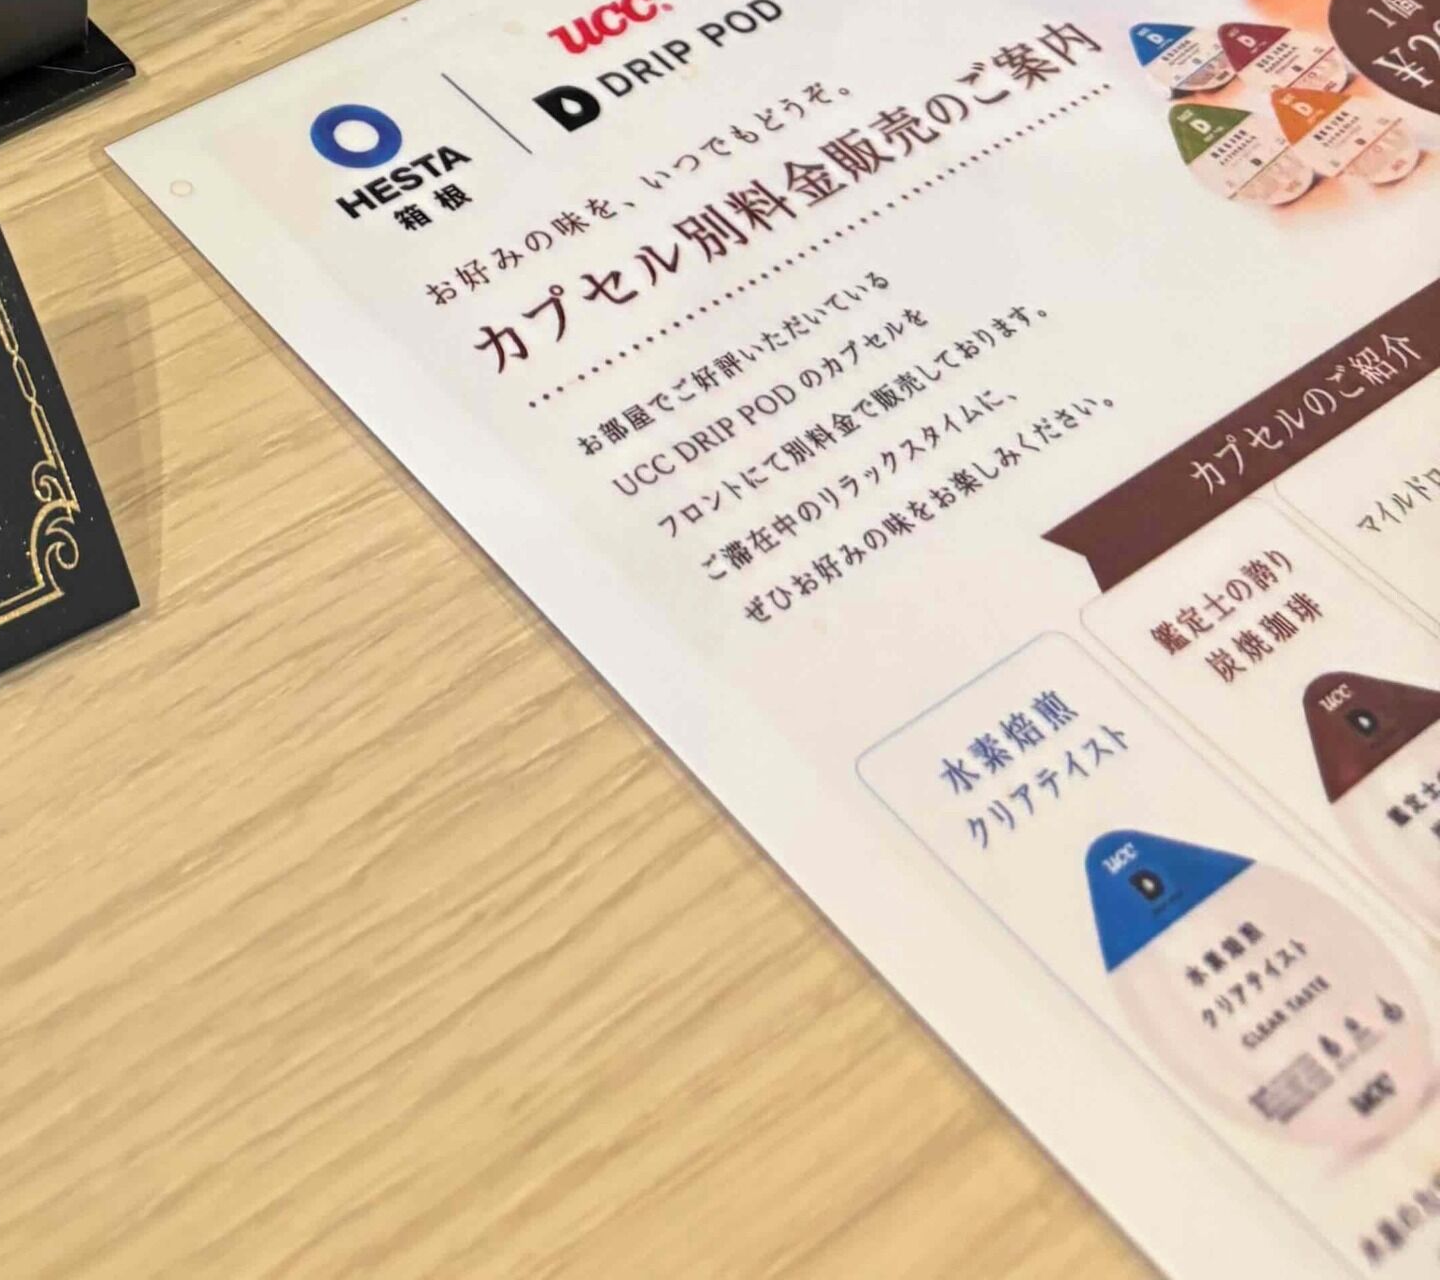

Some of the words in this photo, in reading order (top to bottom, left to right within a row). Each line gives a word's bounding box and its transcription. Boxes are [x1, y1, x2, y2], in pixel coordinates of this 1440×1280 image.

[597, 39, 692, 98] DRIP
[335, 144, 472, 220] HESTA
[393, 183, 474, 232] 箱根
[426, 81, 852, 307] お好みの味を、いつでもどうぞ。
[474, 19, 1104, 373] カプセル別料金販売のご案内
[578, 272, 890, 457] お部屋でご好評いただいている
[613, 453, 677, 498] UCC
[677, 416, 737, 465] DRIP
[740, 383, 798, 428] POD
[799, 307, 930, 390] のカプセルを
[660, 304, 1049, 538] フロントにて別料金で販売しております。
[1191, 333, 1422, 496] カプセルのご紹介
[701, 388, 1020, 582] ご滞在中のリラックスタイムに、
[745, 396, 1116, 624] ぜひお好みの味をお楽しみください。
[1150, 548, 1295, 656] 鑑定士の誇り
[1205, 591, 1324, 684] 炭焼珈琲
[939, 690, 1080, 796] 水素焙煎
[966, 725, 1129, 850] クリアテイスト
[1101, 841, 1140, 876] UCC
[1241, 1009, 1288, 1051] CLEAR
[1284, 974, 1332, 1014] TASTE
